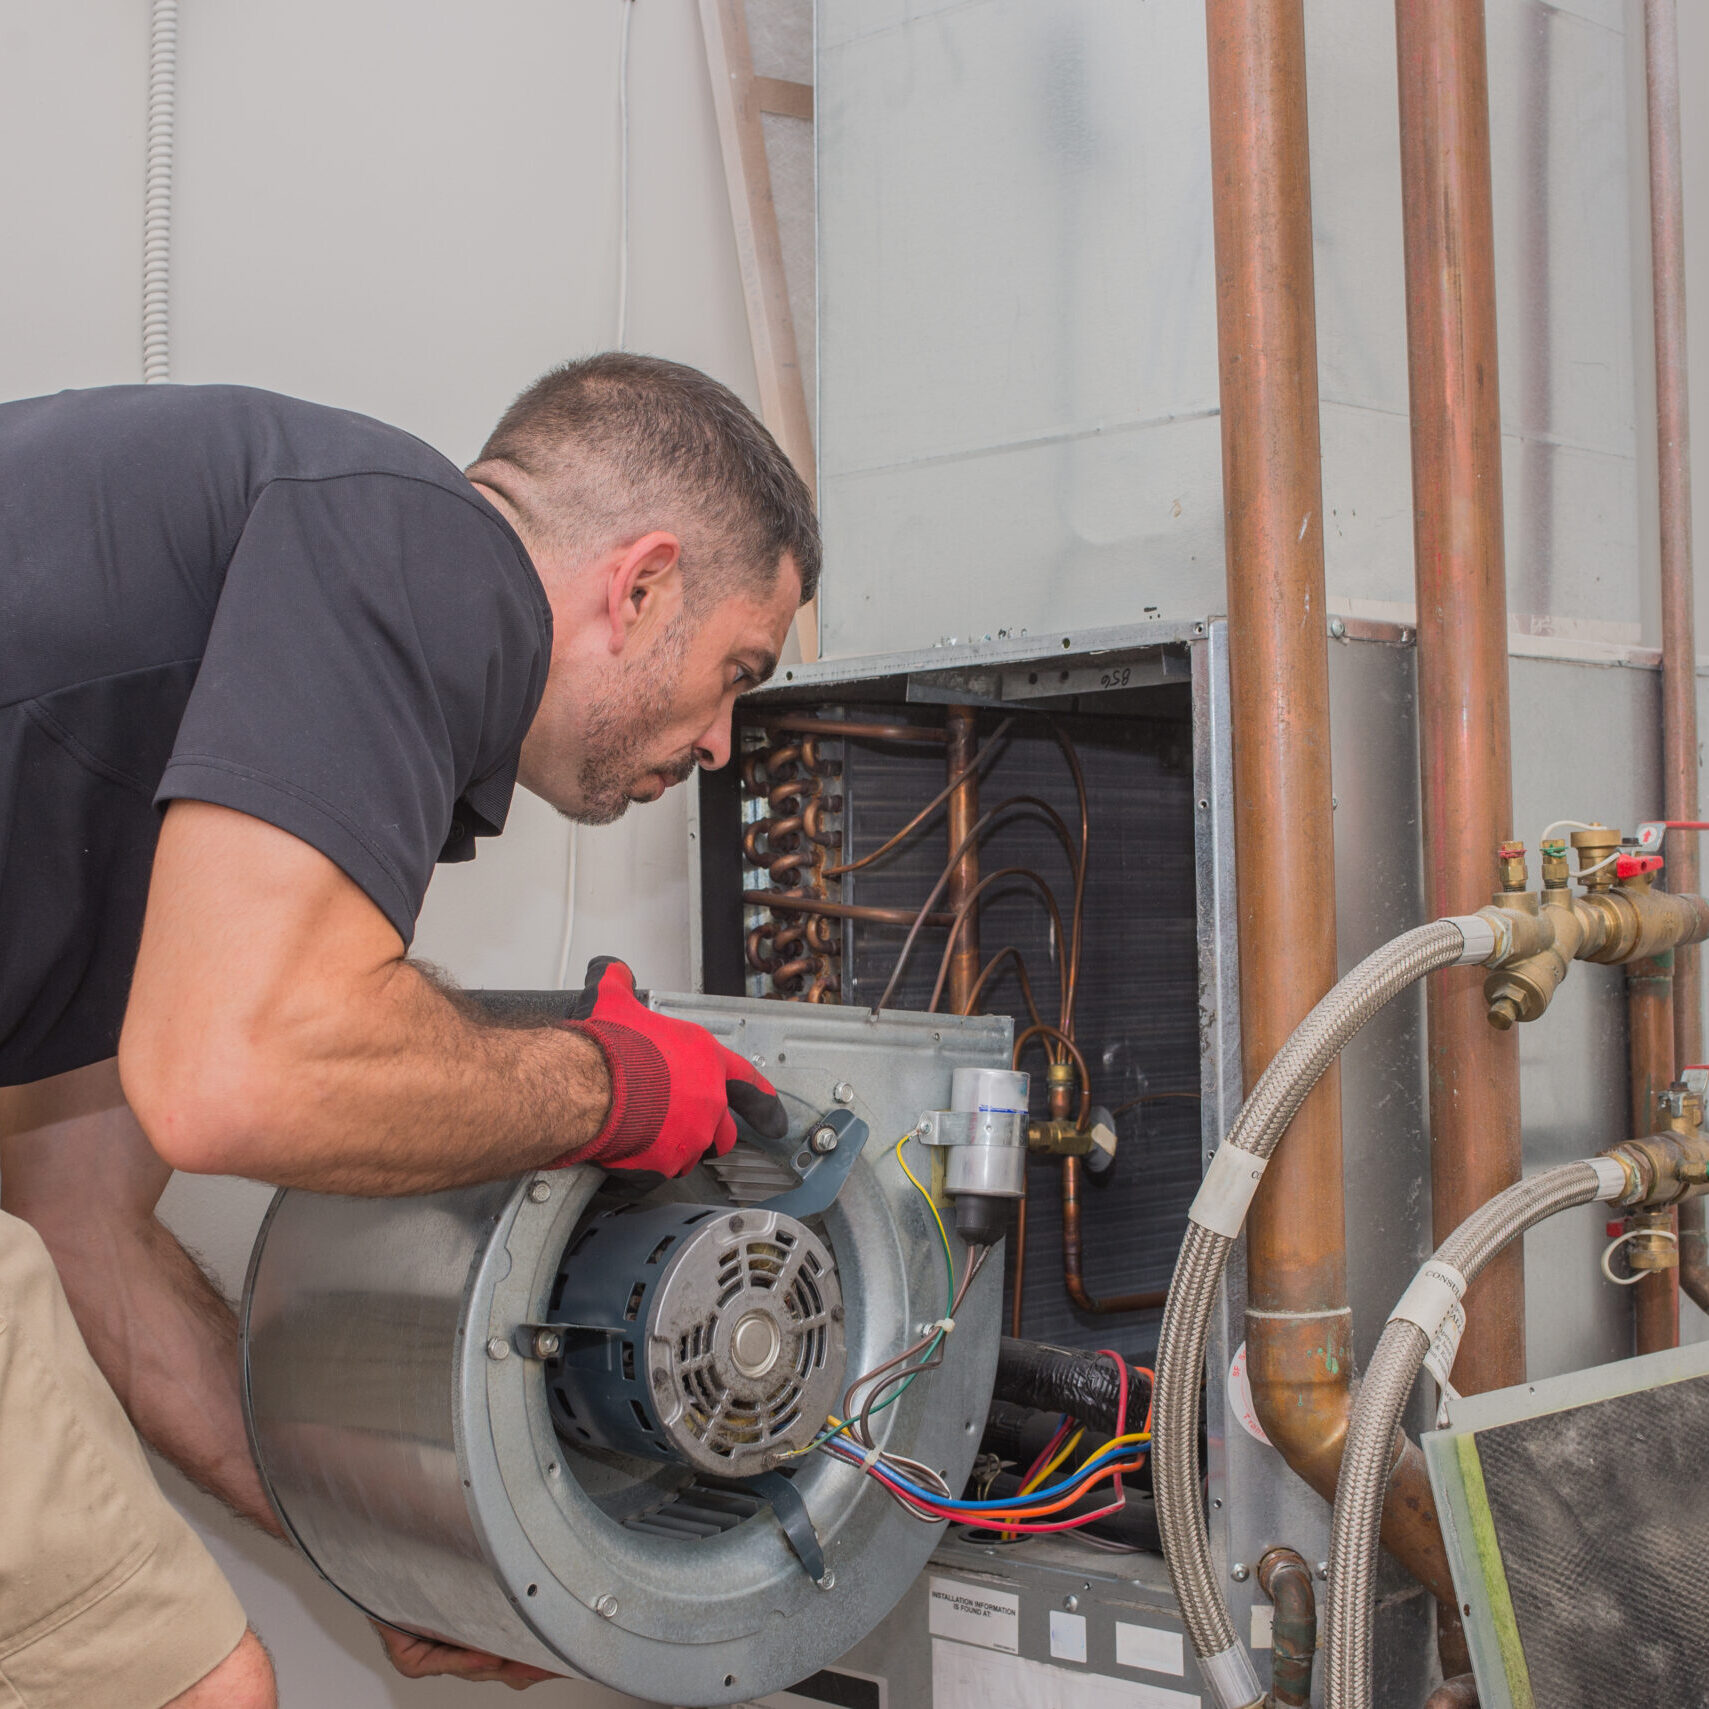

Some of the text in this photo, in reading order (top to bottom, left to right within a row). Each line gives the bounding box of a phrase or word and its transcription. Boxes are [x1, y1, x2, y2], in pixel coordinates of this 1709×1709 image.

[932, 1592, 1016, 1616] INSTALLATION INFORMATION
[961, 1604, 982, 1615] FOUND
